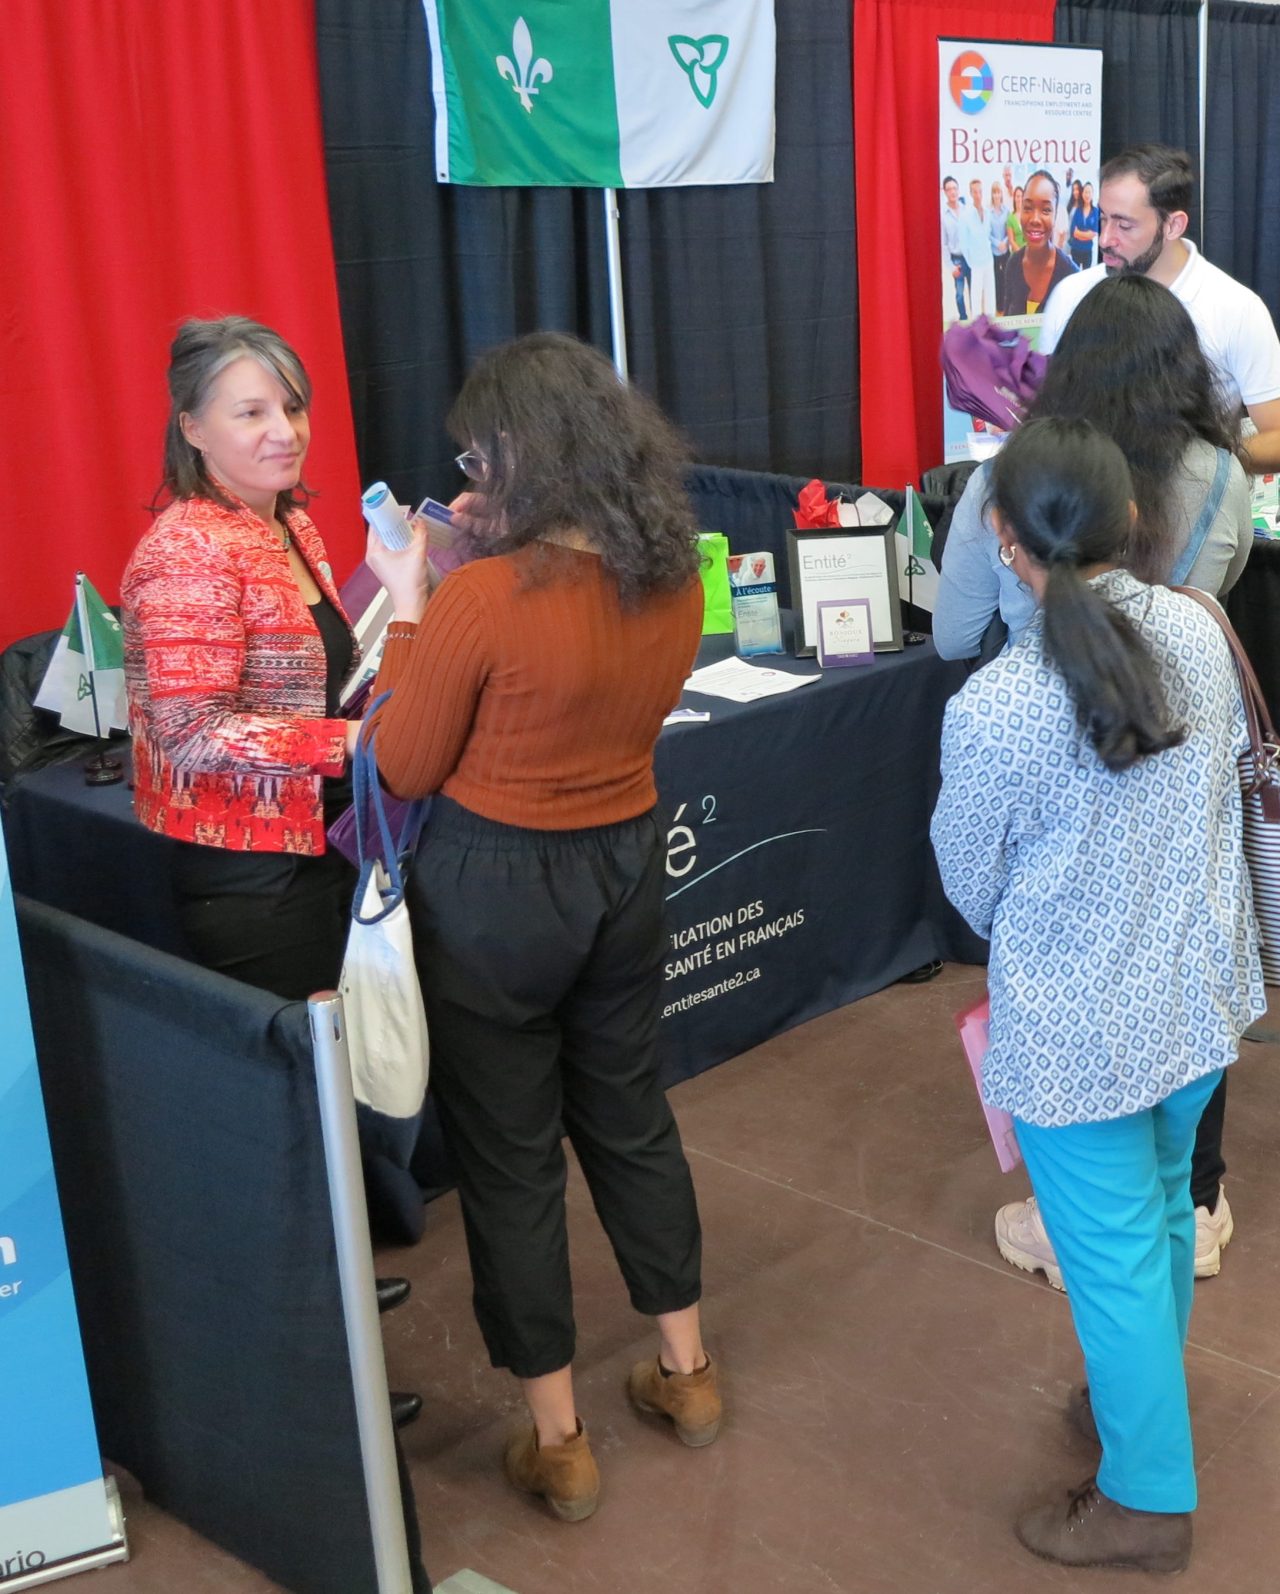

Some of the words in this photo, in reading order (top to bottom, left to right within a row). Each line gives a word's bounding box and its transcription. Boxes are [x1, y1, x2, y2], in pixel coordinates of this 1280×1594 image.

[1044, 109, 1072, 117] RESOURCE
[1045, 100, 1080, 108] EMPLOYMENT
[950, 127, 1092, 164] Bienvenue
[670, 912, 733, 950] ICATION
[737, 900, 765, 925] DES
[664, 943, 713, 981] SANTÉ
[715, 938, 736, 960] EN
[739, 908, 805, 951] FRANÇAIS
[0, 1549, 46, 1577] rio
